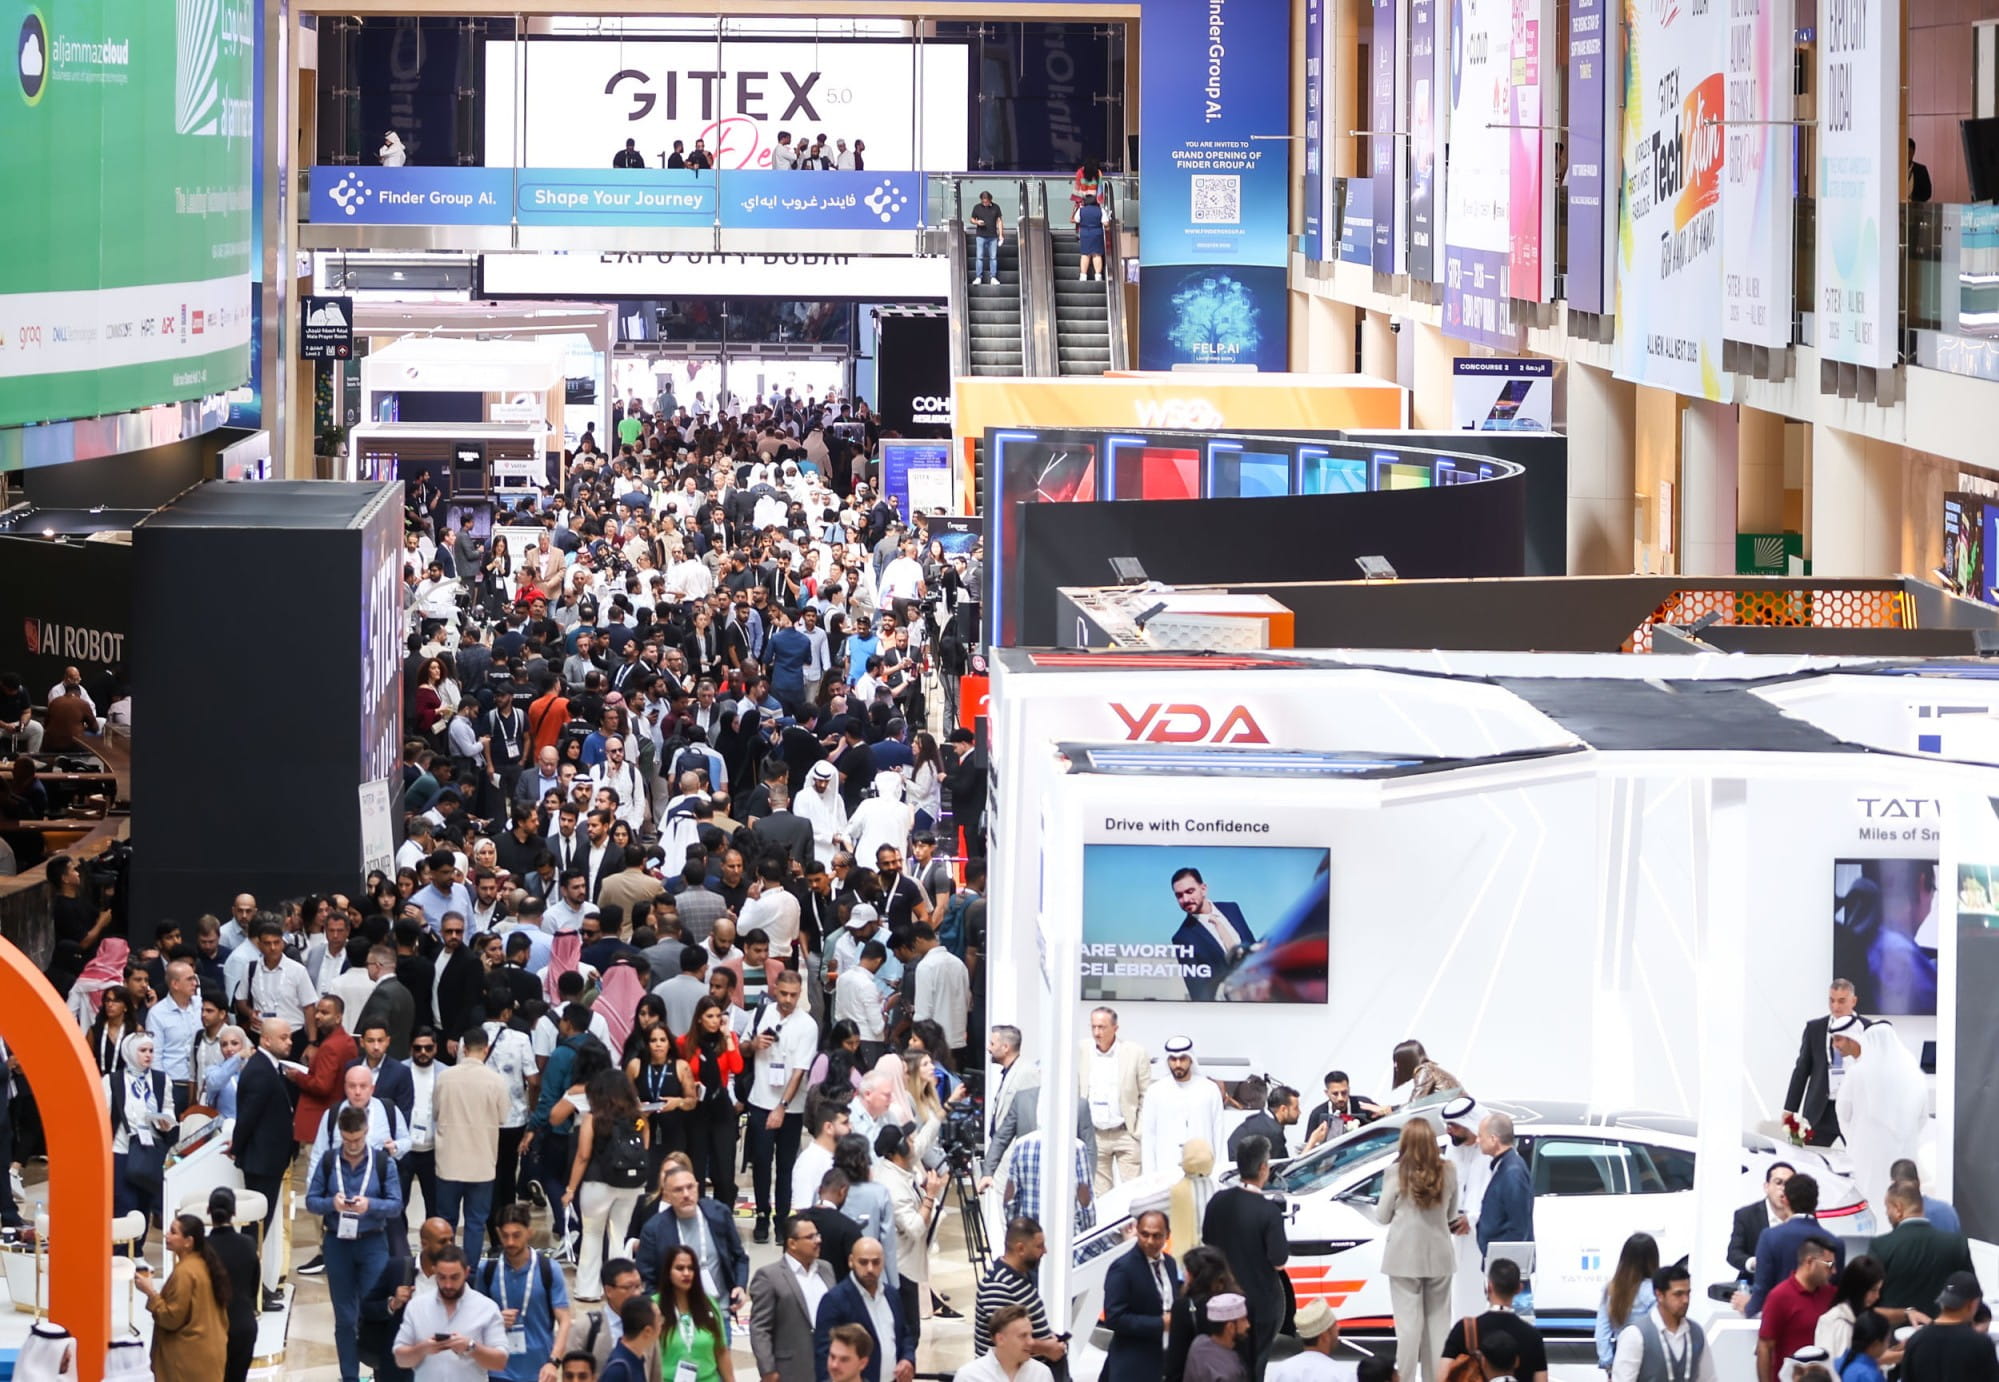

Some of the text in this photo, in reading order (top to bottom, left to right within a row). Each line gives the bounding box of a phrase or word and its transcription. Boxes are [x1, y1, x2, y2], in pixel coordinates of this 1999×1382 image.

[605, 69, 853, 121] GITEX 5.0
[1658, 66, 1680, 118] GITEX
[1829, 62, 1852, 131] DUBAI
[1206, 100, 1221, 123] Ai.
[1172, 151, 1262, 160] GRAND OPENING OF
[1177, 160, 1255, 169] FINDER GROUP AI
[379, 191, 497, 207] Finder Group Ai.
[535, 189, 703, 210] Shape Your Journey
[781, 195, 818, 210] غروب
[820, 193, 857, 210] فايندر
[1193, 343, 1240, 354] FELP.AI
[1460, 363, 1503, 371] CONCOURSE
[42, 623, 124, 664] AI ROBOT
[1107, 702, 1271, 745] YDA
[1105, 817, 1270, 833] Drive with Confidence
[1859, 827, 1897, 840] Miles
[1902, 828, 1916, 840] of
[1120, 944, 1194, 958] WORTH
[1080, 963, 1212, 978] CELEBRATING
